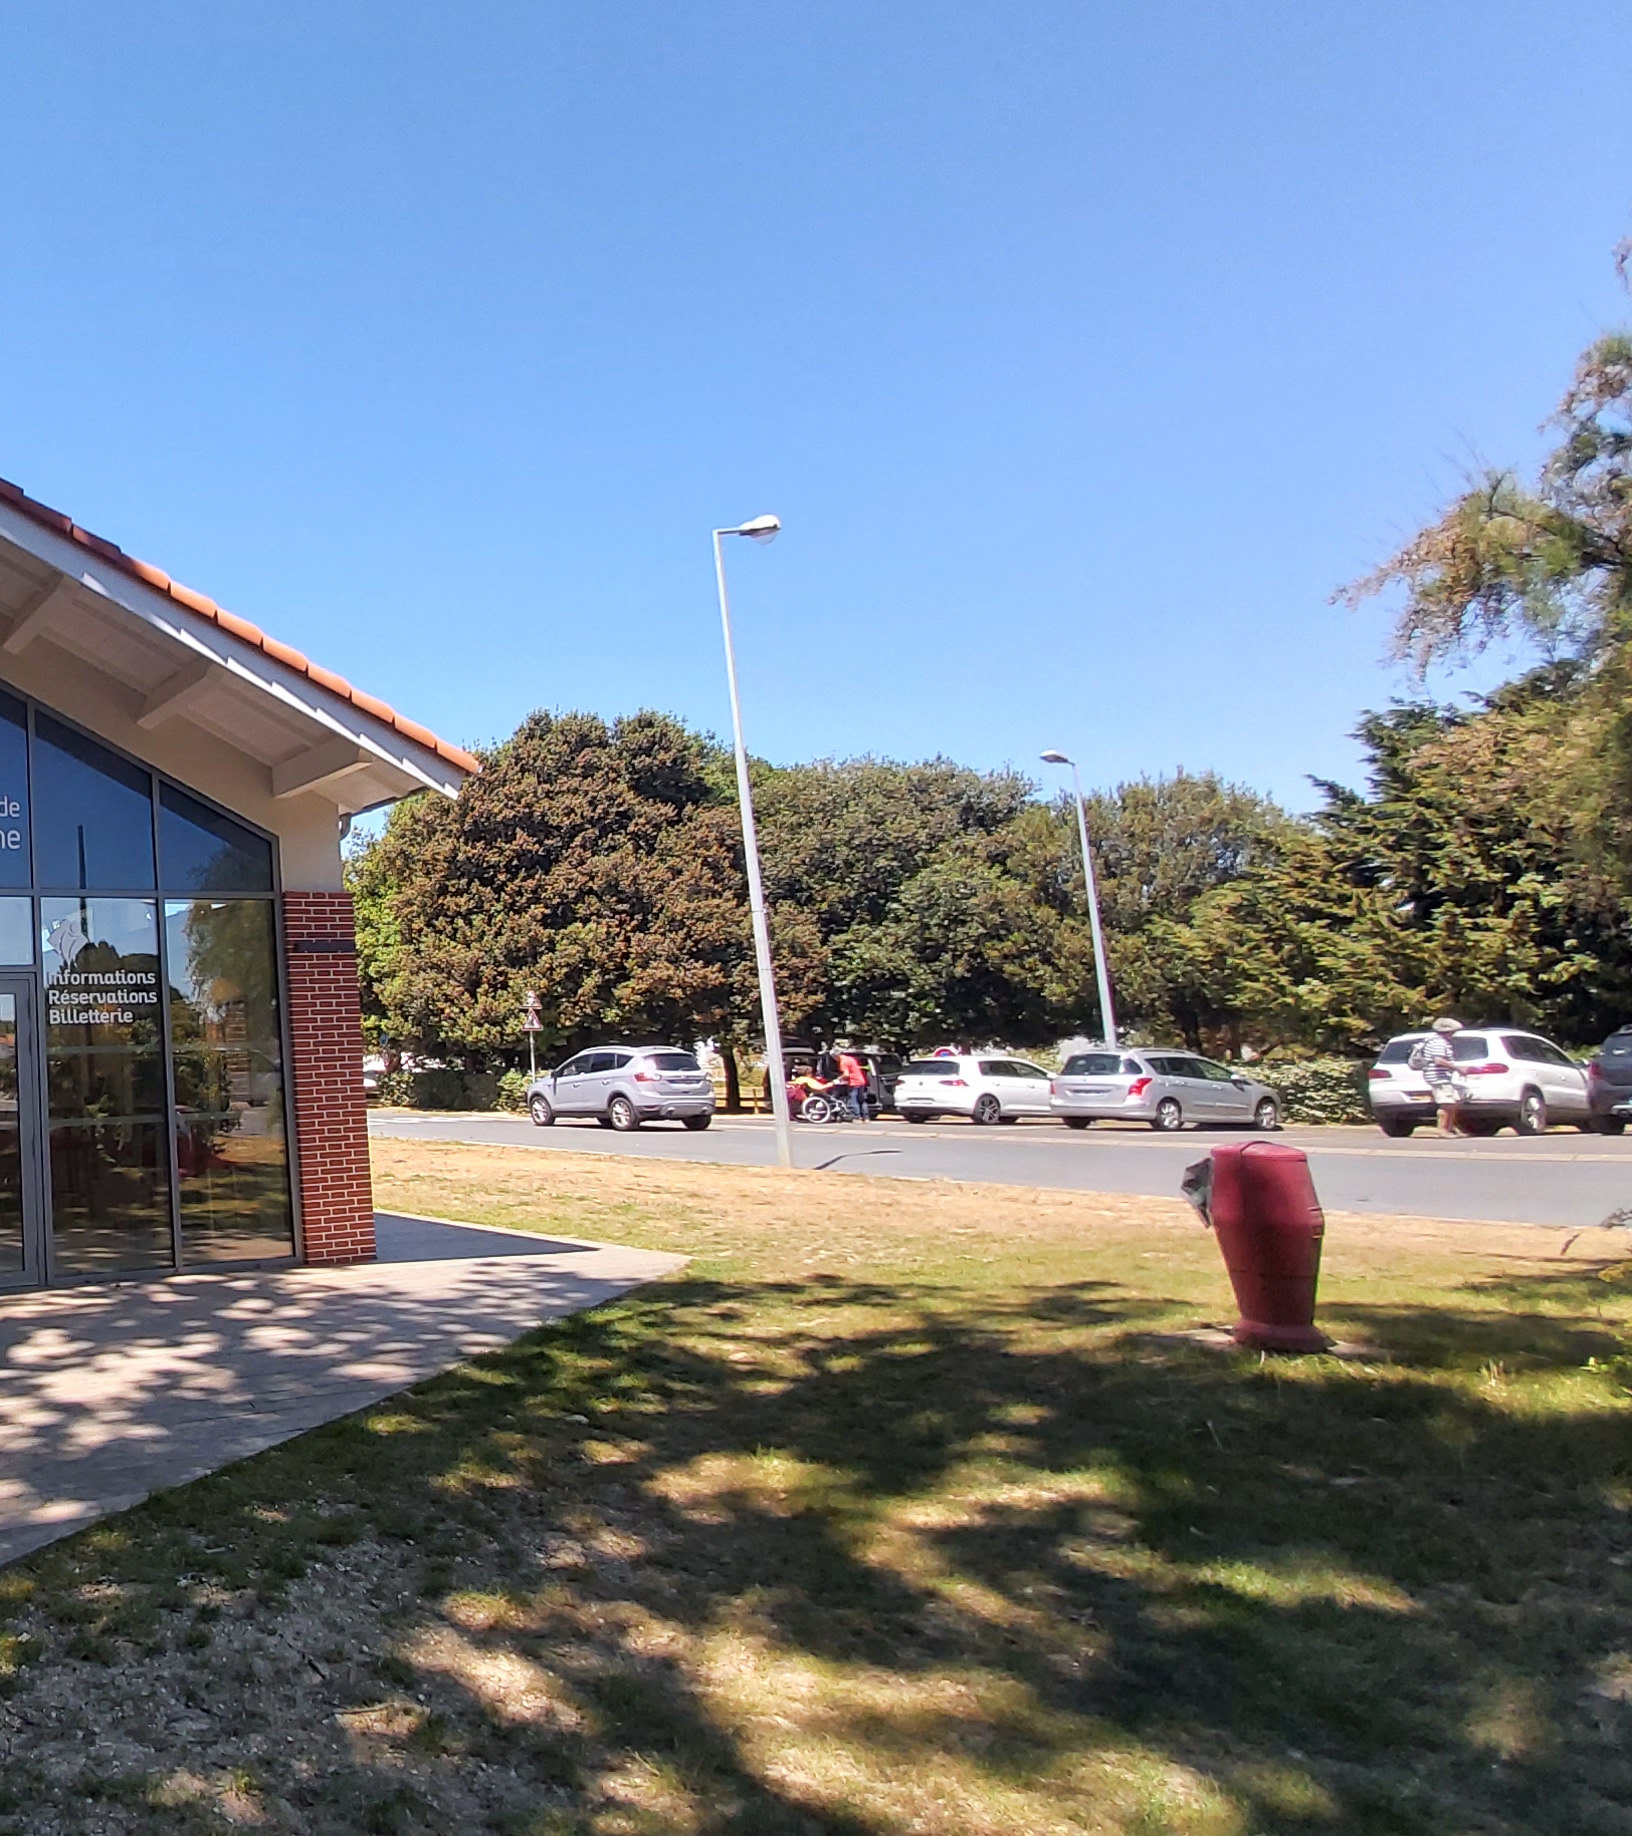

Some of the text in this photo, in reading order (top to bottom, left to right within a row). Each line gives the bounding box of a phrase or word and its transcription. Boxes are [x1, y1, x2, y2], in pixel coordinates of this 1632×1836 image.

[48, 969, 156, 985] Informations
[49, 989, 158, 1004] Réservations
[50, 1008, 133, 1025] Billetterie
